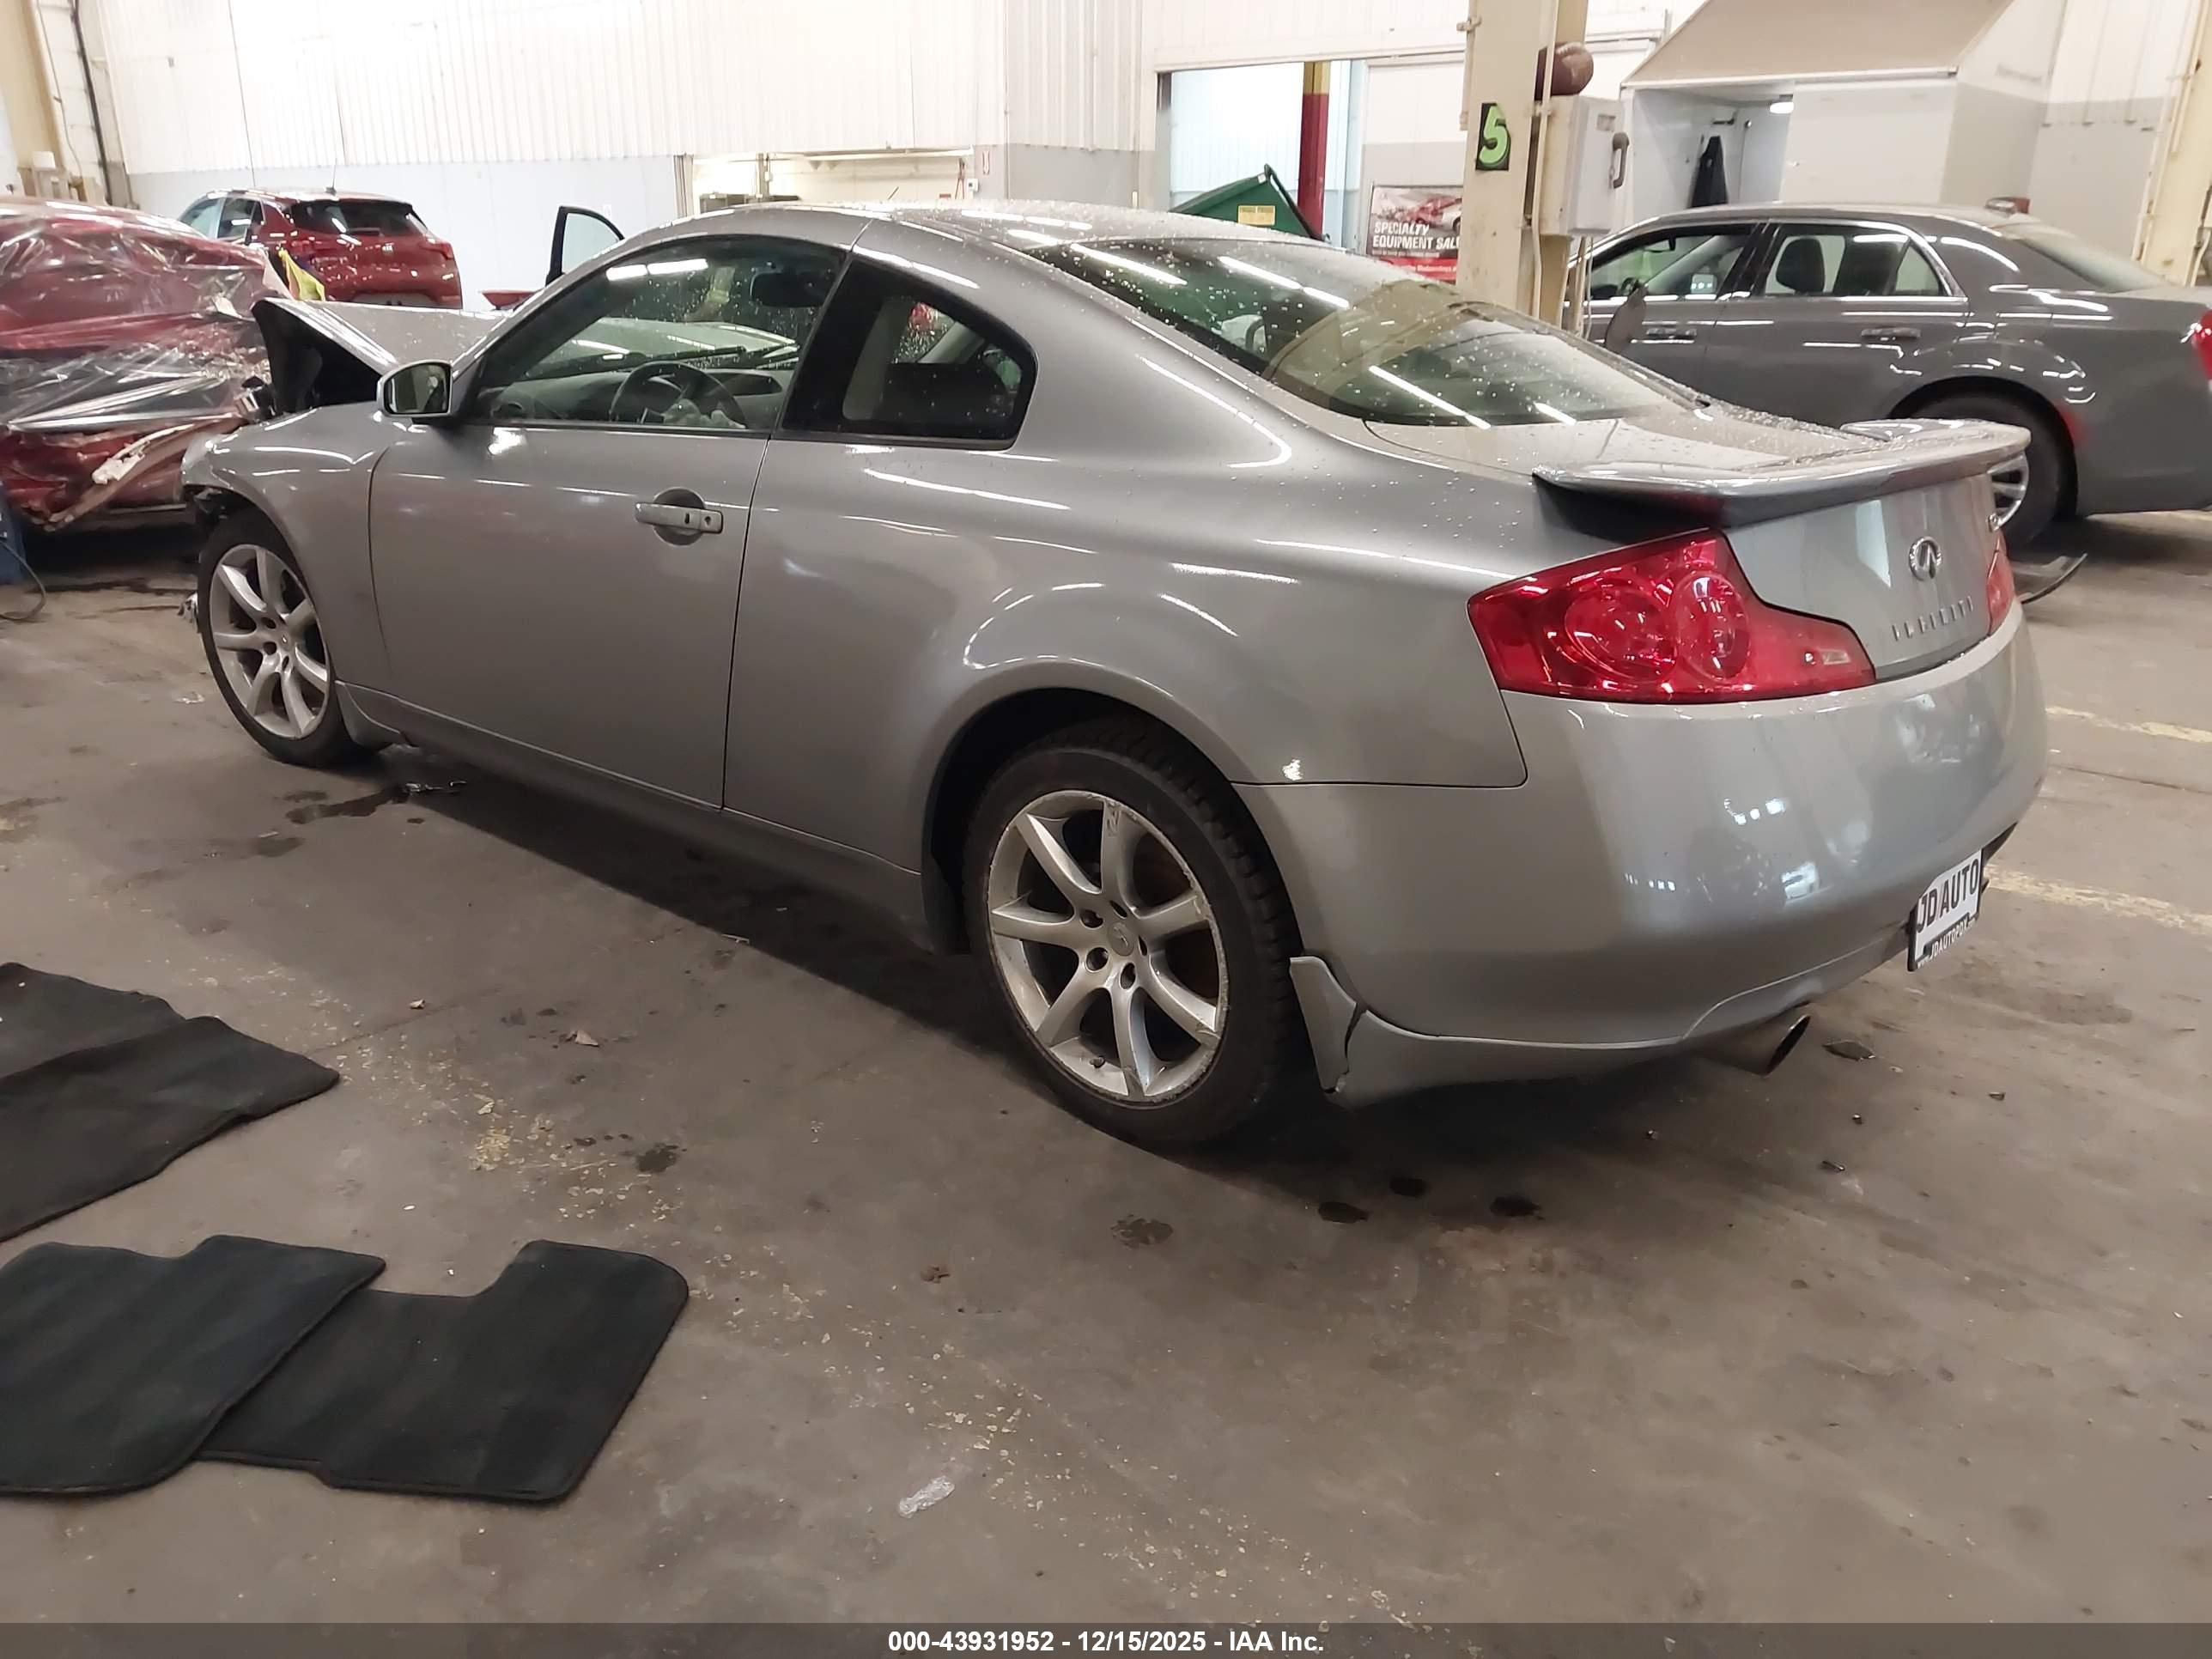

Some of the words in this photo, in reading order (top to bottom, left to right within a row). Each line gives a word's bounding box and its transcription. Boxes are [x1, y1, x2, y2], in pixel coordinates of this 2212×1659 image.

[1478, 105, 1510, 166] 5
[1372, 234, 1433, 250] EQUIPMENT
[1374, 221, 1429, 235] SPECIALTY
[1916, 887, 1938, 933] JD
[1939, 858, 1979, 919] AUTO
